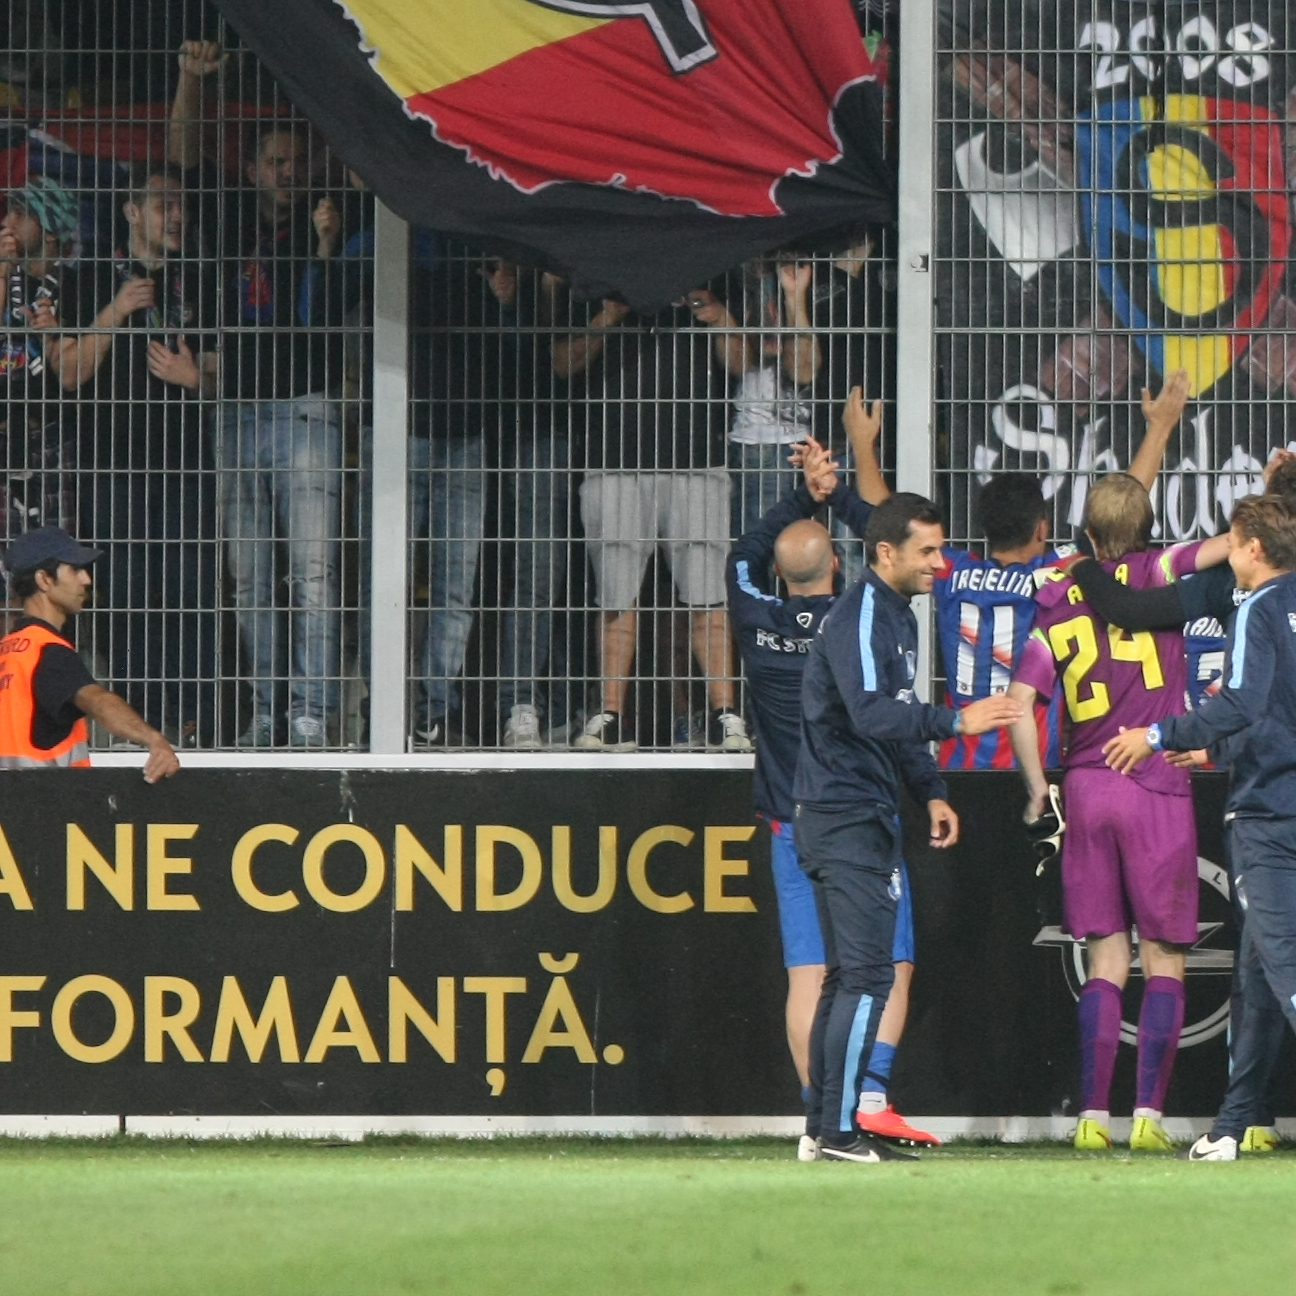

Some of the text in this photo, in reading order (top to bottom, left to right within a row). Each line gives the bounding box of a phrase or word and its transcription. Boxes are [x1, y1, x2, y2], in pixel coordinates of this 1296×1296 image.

[1080, 14, 1275, 90] 2008
[757, 629, 781, 651] FC
[1049, 615, 1164, 723] 24
[66, 822, 201, 911] NE
[230, 822, 759, 914] CONDUCE
